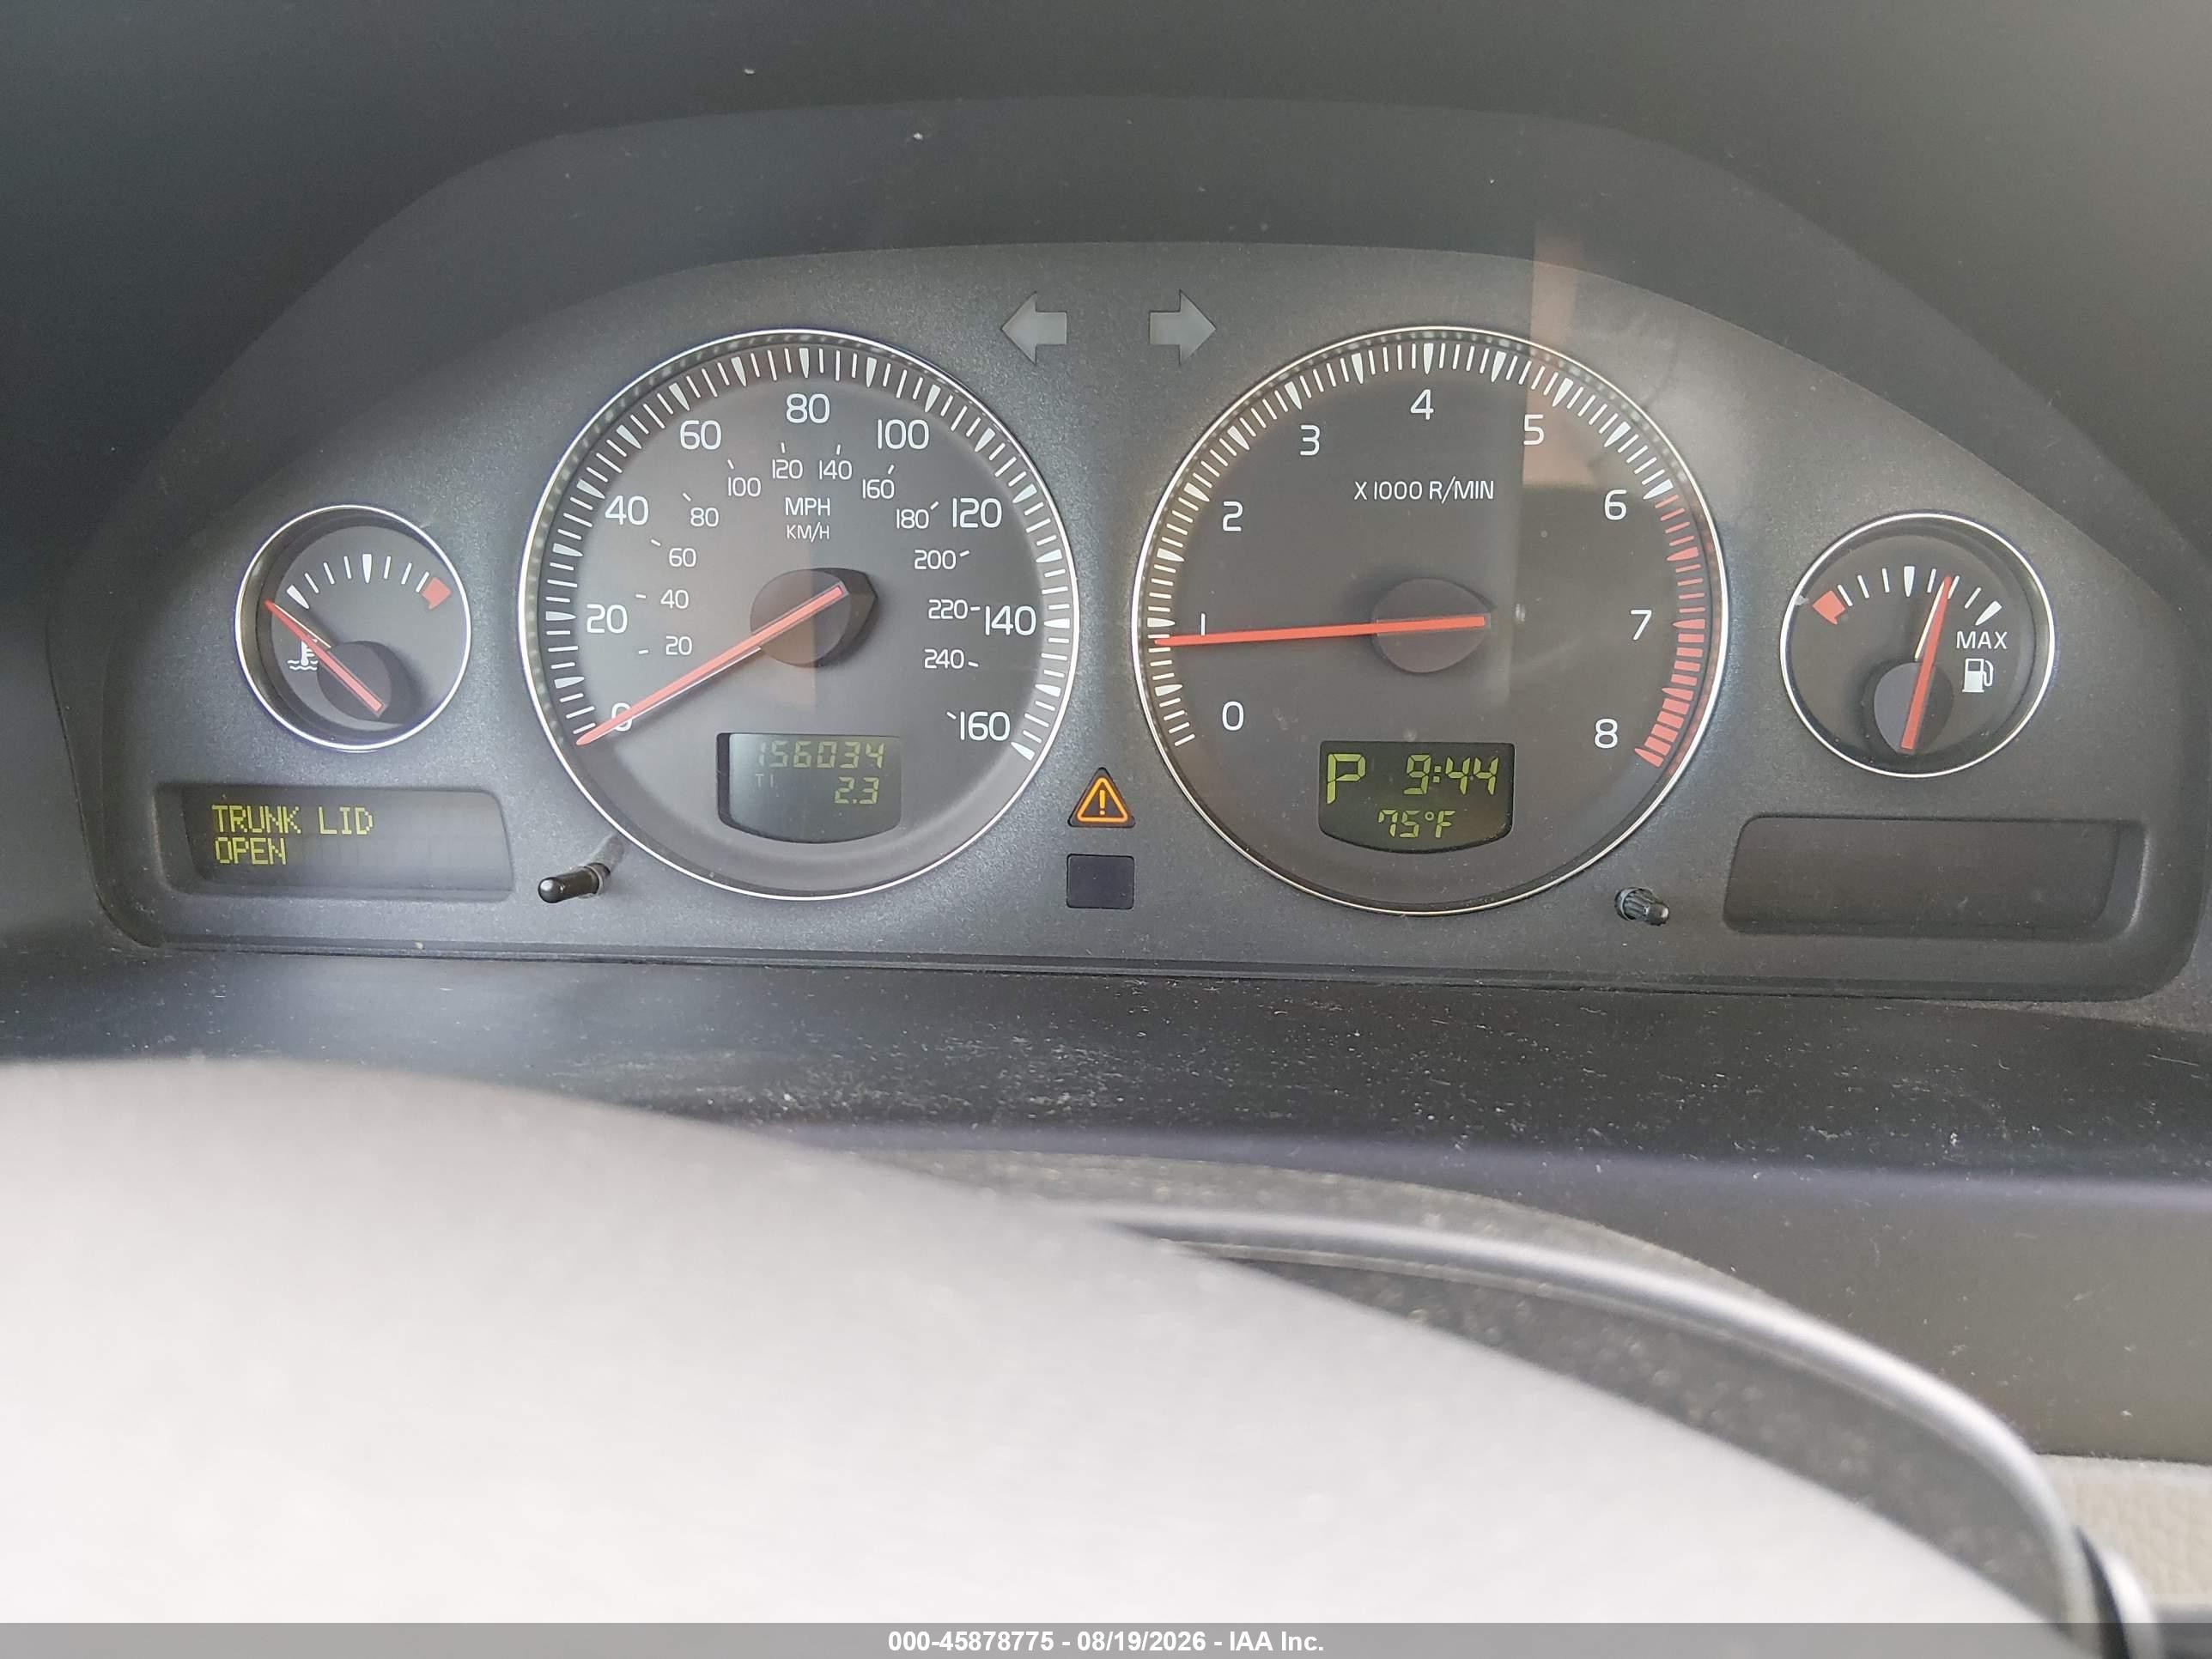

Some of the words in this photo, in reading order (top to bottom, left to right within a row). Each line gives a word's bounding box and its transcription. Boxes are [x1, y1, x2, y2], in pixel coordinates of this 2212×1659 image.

[786, 393, 830, 424] 80
[1411, 389, 1433, 420] 4
[679, 420, 721, 450] 60
[877, 419, 929, 450] 100
[1300, 425, 1320, 456] 3
[1523, 414, 1544, 446] 5
[772, 459, 803, 479] 120
[818, 460, 852, 480] 140
[727, 477, 761, 497] 100
[861, 479, 895, 500] 160
[1353, 481, 1367, 501] X
[1373, 481, 1422, 501] 1000
[1429, 477, 1494, 504] R/MIN
[605, 495, 649, 526] 40
[690, 507, 719, 527] 80
[785, 497, 830, 517] MPH
[896, 509, 929, 529] 180
[951, 498, 1002, 528] 120
[1222, 501, 1243, 532] 2
[1605, 489, 1626, 520] 6
[786, 522, 830, 540] KM/H
[668, 548, 697, 568] 60
[914, 550, 956, 570] 200
[660, 590, 689, 609] 40
[928, 600, 968, 620] 220
[586, 605, 628, 634] 20
[984, 605, 1036, 636] 140
[1630, 609, 1652, 641] 7
[665, 636, 692, 655] 20
[1956, 631, 2008, 650] MAX
[924, 649, 964, 670] 240
[611, 702, 635, 732] 0
[959, 711, 1011, 741] 160
[1222, 701, 1244, 731] 0
[1595, 718, 1619, 750] 8
[757, 741, 885, 769] 156034
[834, 776, 879, 805] 2.3
[1327, 752, 1366, 804] P
[1404, 754, 1499, 795] 9:44
[212, 805, 301, 834] TRUNK
[318, 805, 374, 836] LID
[214, 836, 287, 866] OPEN
